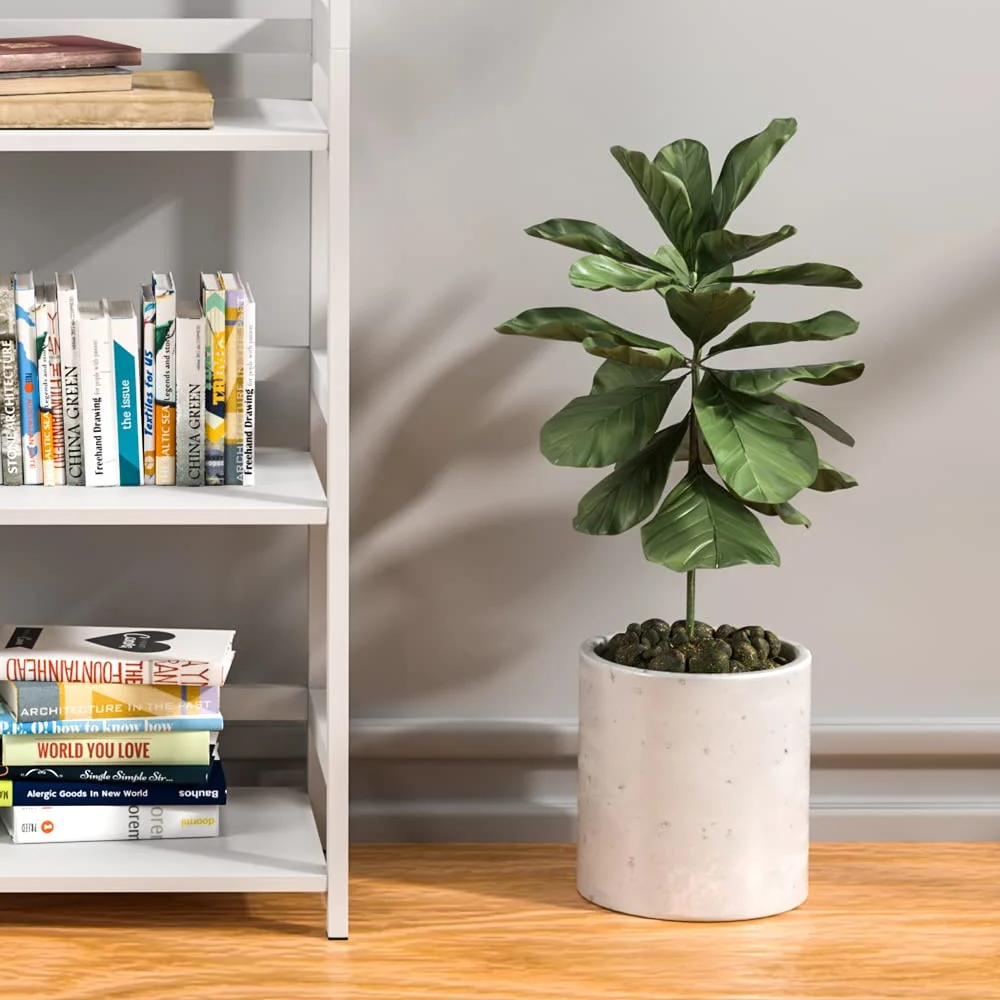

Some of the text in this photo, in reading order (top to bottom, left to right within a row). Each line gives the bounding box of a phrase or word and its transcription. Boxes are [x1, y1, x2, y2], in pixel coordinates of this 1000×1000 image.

[65, 366, 80, 420] GREEN
[144, 370, 154, 388] for
[164, 370, 172, 401] Legends
[2, 340, 18, 474] STONE ARCHITECTURE
[92, 397, 102, 433] Drawing
[120, 380, 132, 430] the issue
[144, 389, 154, 436] Textiles
[161, 405, 170, 425] SEA
[244, 389, 254, 428] Drawing
[43, 433, 52, 460] ALTIC
[188, 384, 201, 480] CHINA GREEN
[67, 422, 82, 479] CHINA
[94, 435, 104, 475] Freehand
[244, 431, 253, 475] Freehand
[6, 658, 123, 685] FOUNTAINHEAD
[125, 660, 143, 685] THE
[20, 703, 123, 717] ARCHITECTURE
[127, 702, 139, 711] IN
[147, 701, 173, 711] THE
[31, 721, 49, 734] O!
[53, 720, 81, 734] how
[85, 722, 99, 733] to
[102, 720, 140, 733] know
[144, 719, 174, 732] how
[37, 742, 150, 759] WORLD YOU LOVE
[80, 769, 111, 782] Single
[112, 769, 147, 782] Simple
[26, 789, 148, 800] Alergic Goods In New World
[178, 789, 219, 799] Bauhos
